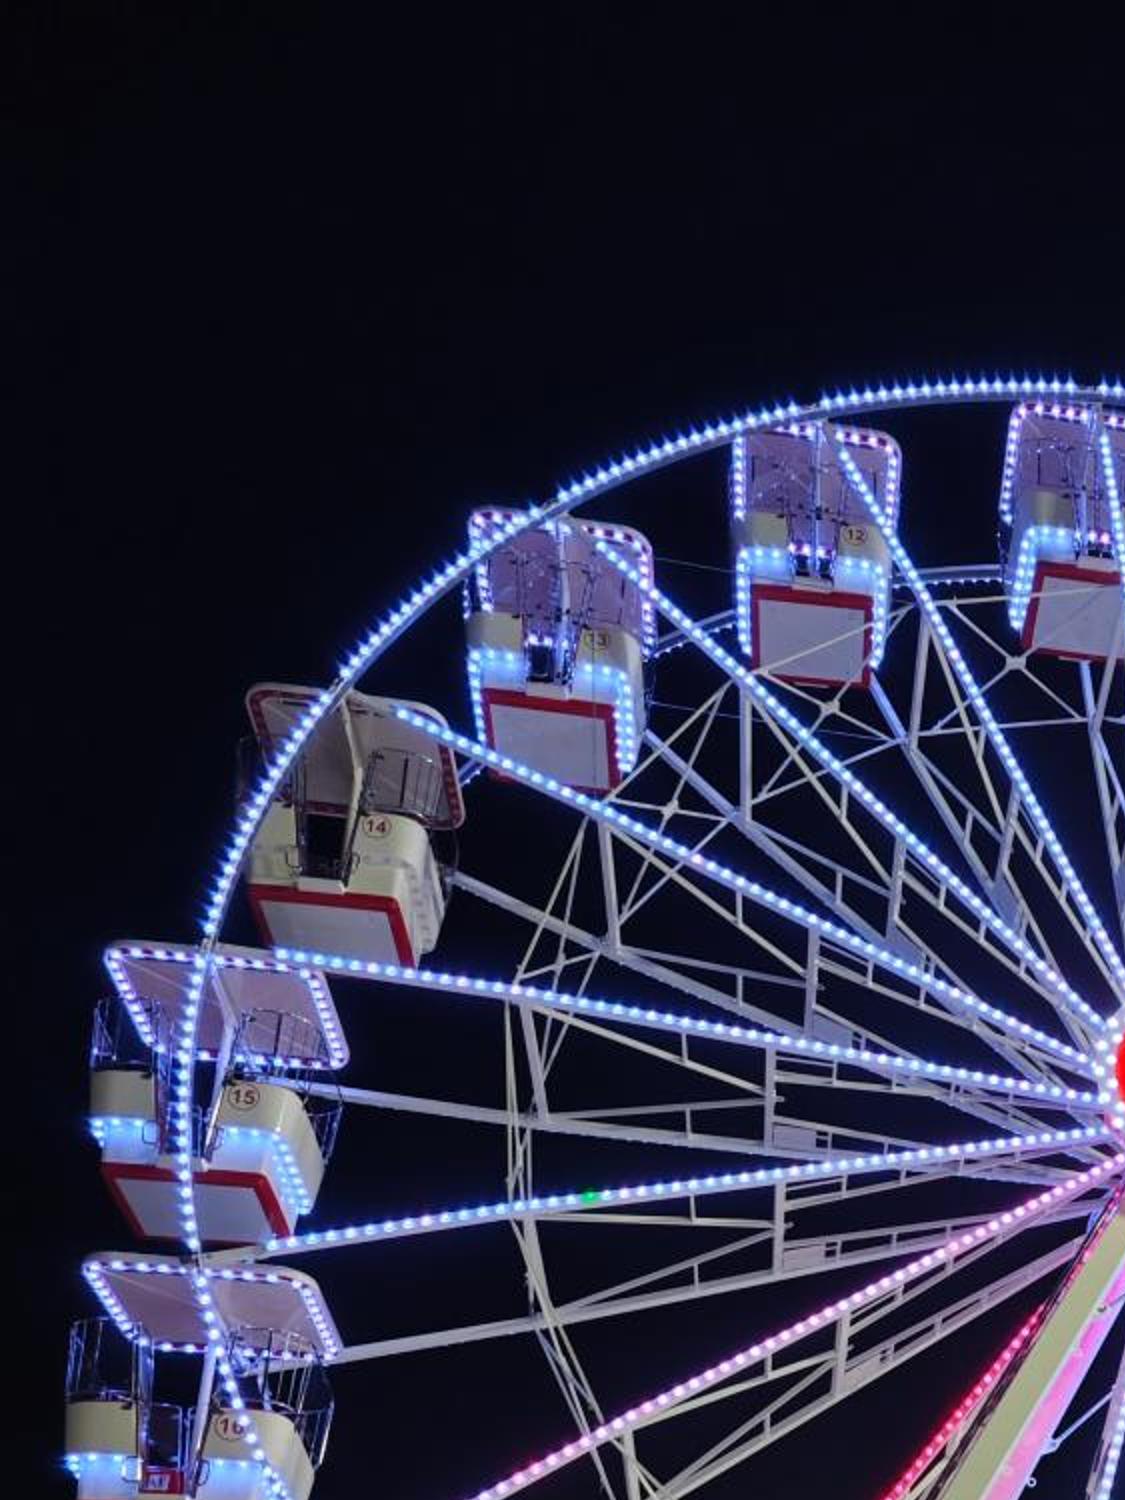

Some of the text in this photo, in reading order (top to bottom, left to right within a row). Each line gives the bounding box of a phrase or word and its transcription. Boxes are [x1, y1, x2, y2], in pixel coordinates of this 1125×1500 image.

[847, 528, 865, 542] 12
[366, 818, 386, 833] 14
[232, 1089, 256, 1105] 15
[220, 1417, 245, 1435] 16
